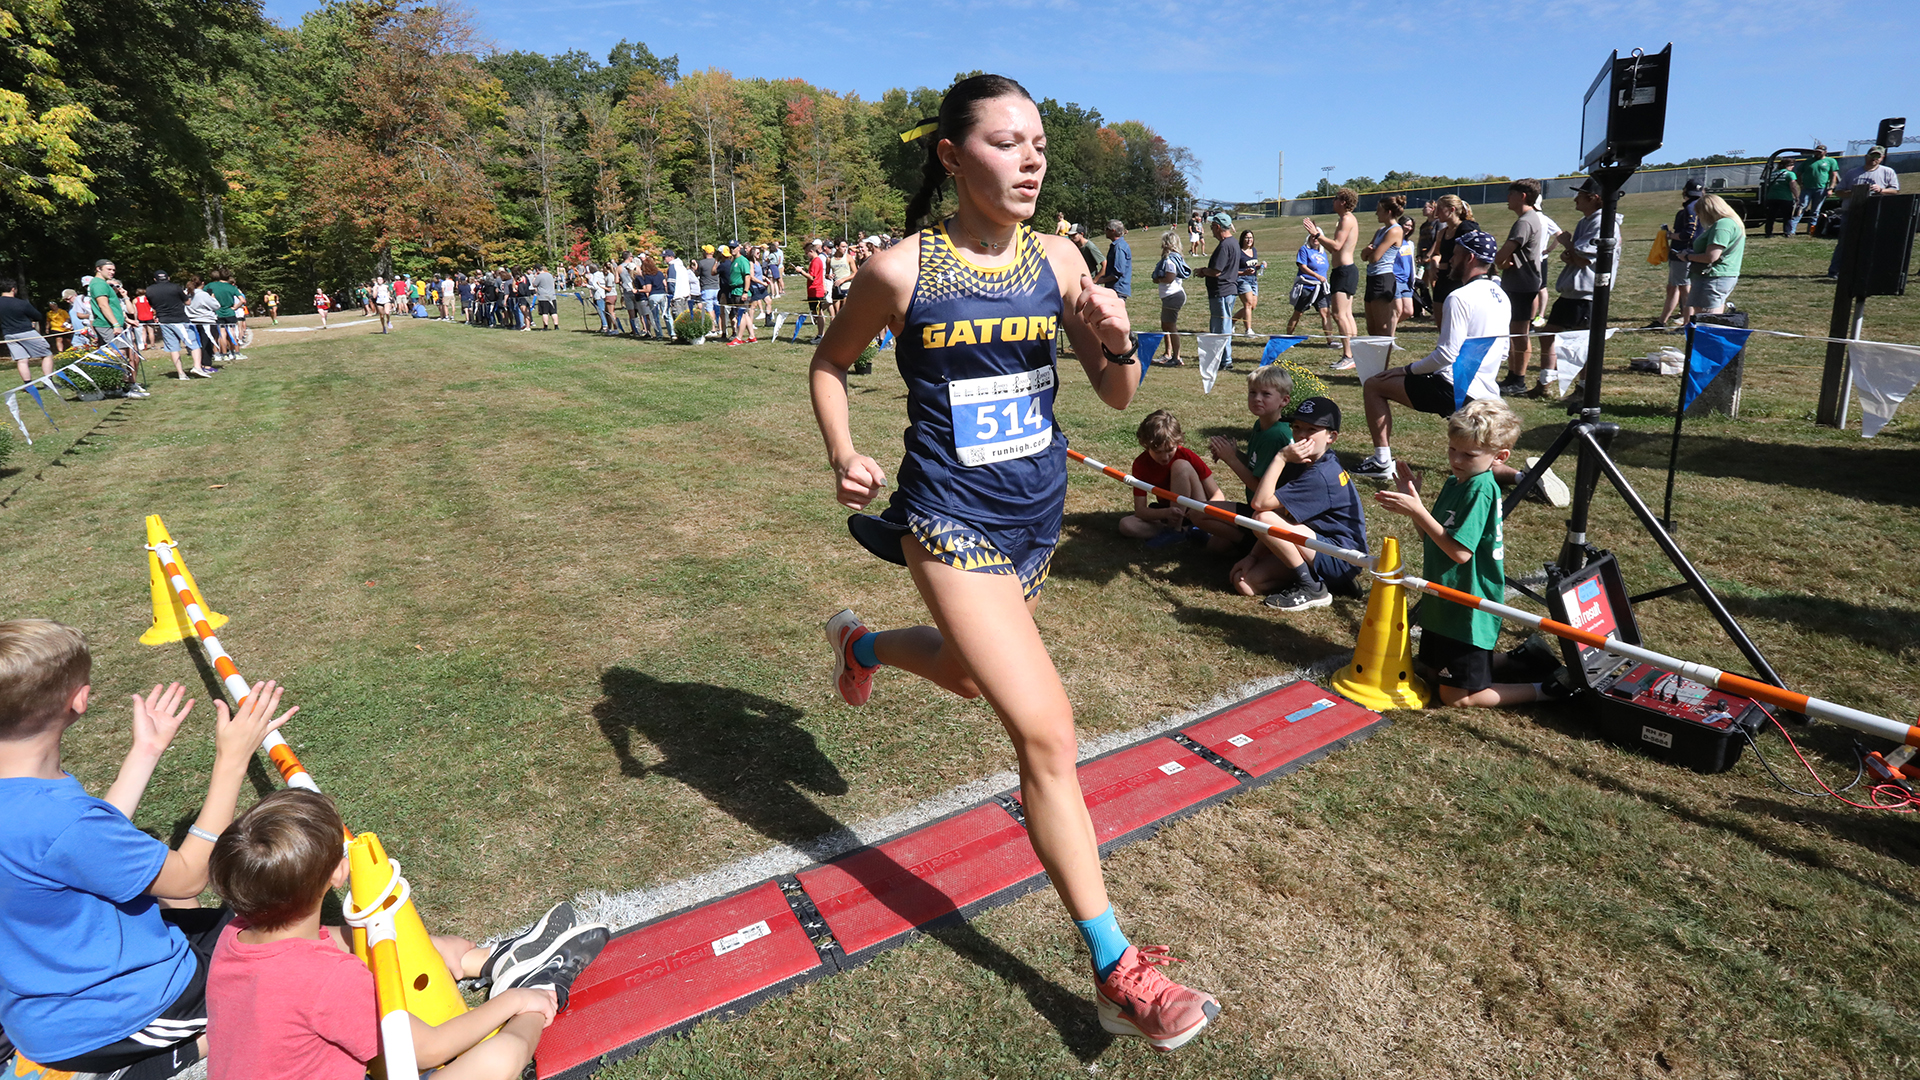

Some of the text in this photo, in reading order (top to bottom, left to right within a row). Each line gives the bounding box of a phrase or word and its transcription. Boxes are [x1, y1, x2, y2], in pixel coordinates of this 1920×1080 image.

[922, 315, 1057, 349] GATORS
[976, 397, 1043, 441] 514
[624, 965, 665, 987] race
[672, 943, 714, 969] resul
